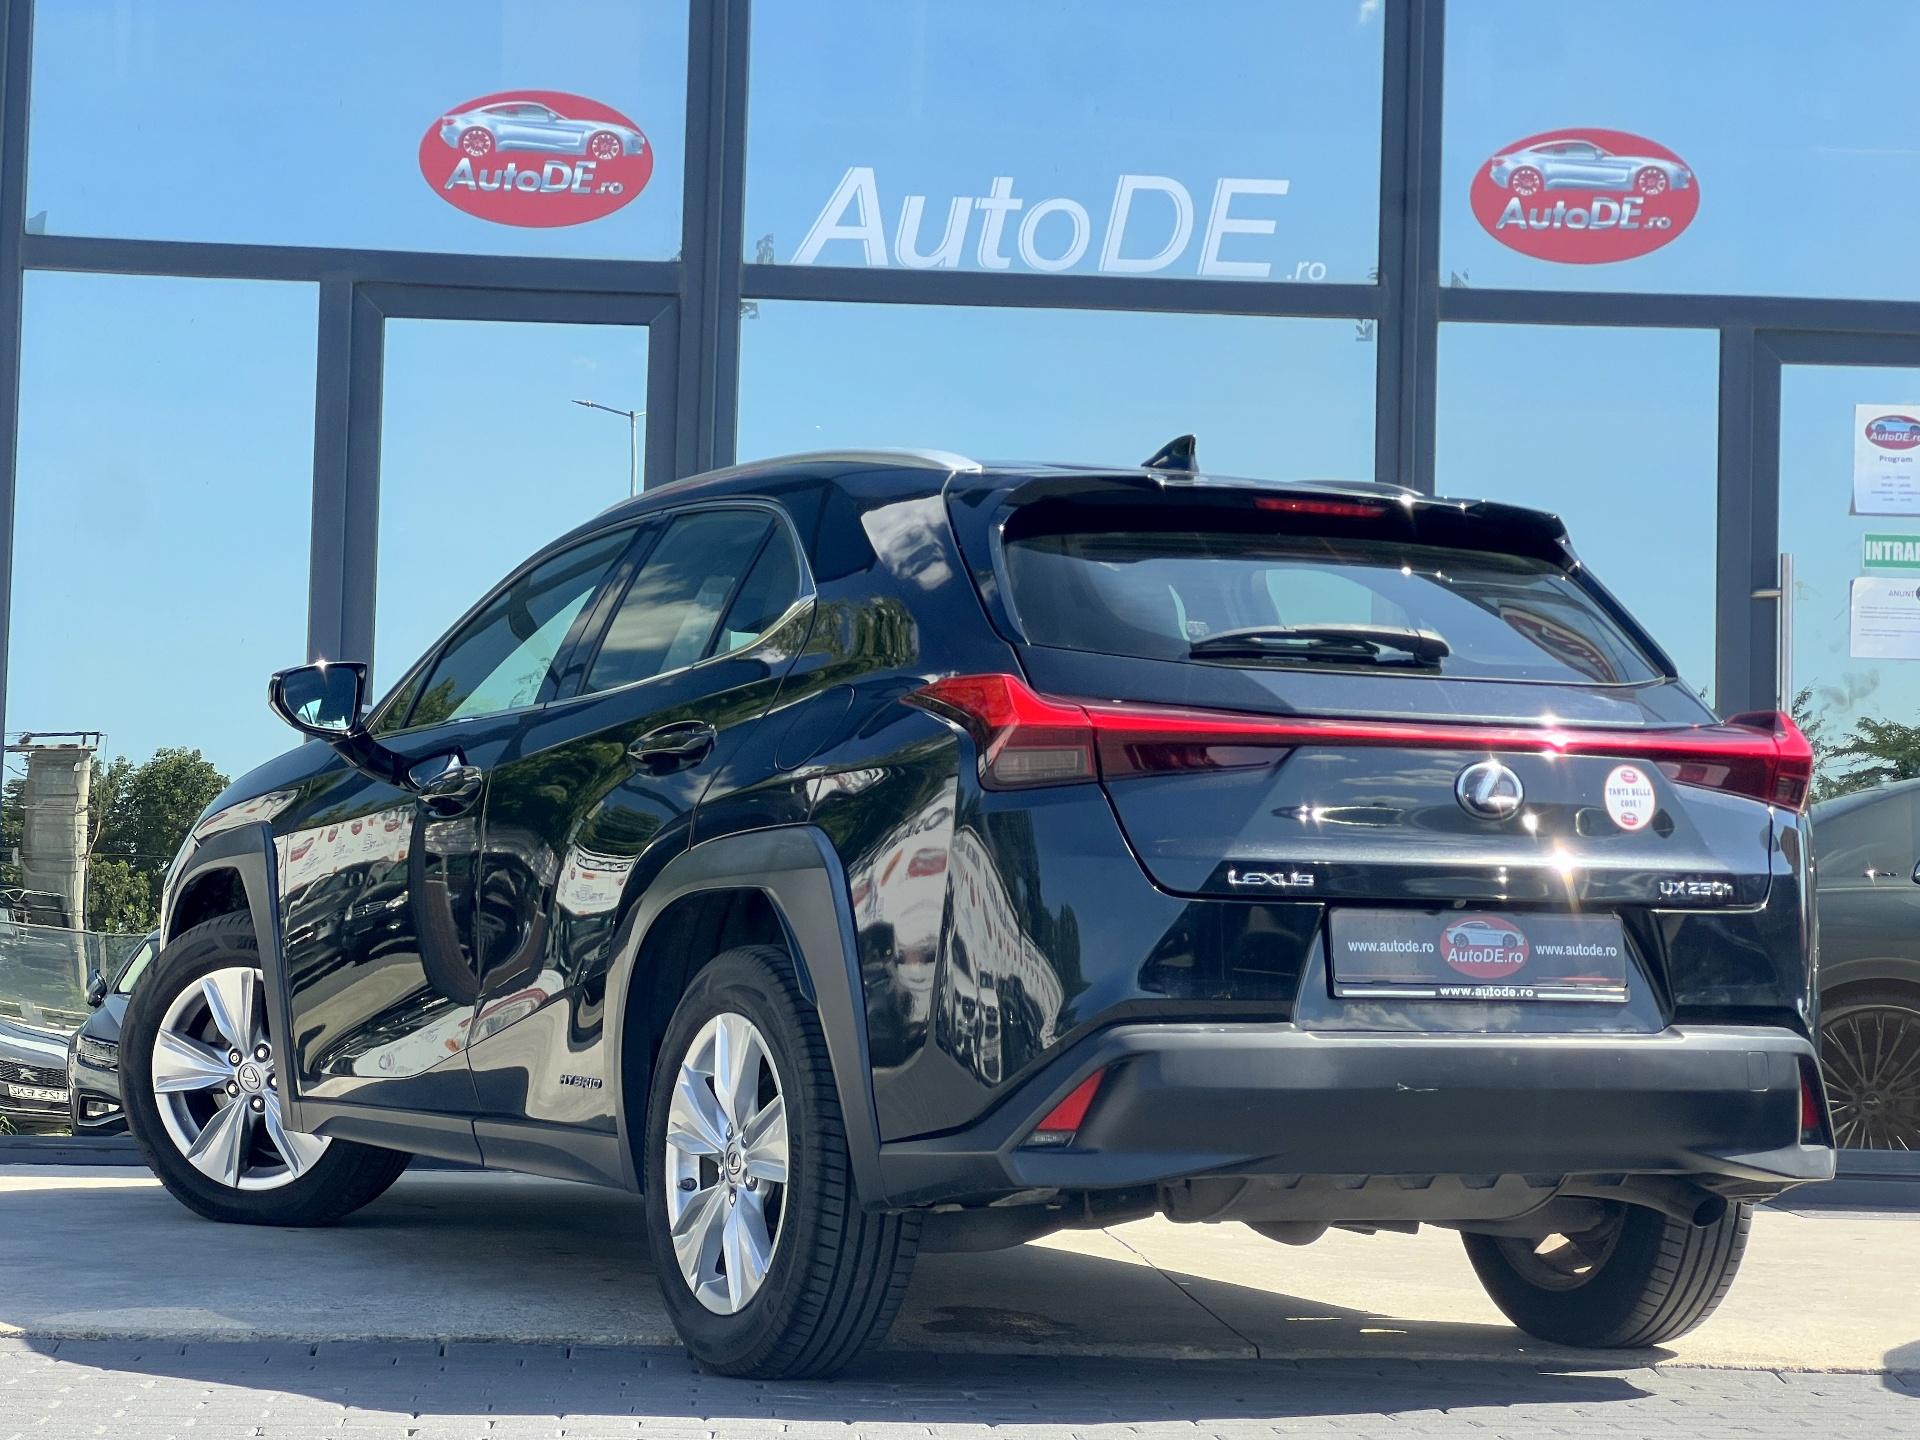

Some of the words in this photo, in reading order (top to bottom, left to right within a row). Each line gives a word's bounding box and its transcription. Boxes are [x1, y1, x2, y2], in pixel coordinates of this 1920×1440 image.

[1880, 455, 1913, 463] Program
[1227, 869, 1315, 886] LEXUS
[1347, 940, 1434, 953] www.autode.ro
[1535, 944, 1618, 957] www.autode.ro
[1447, 948, 1524, 963] AutoDE.ro
[1439, 986, 1534, 998] www.autode.ro
[559, 1074, 603, 1089] HYBRID
